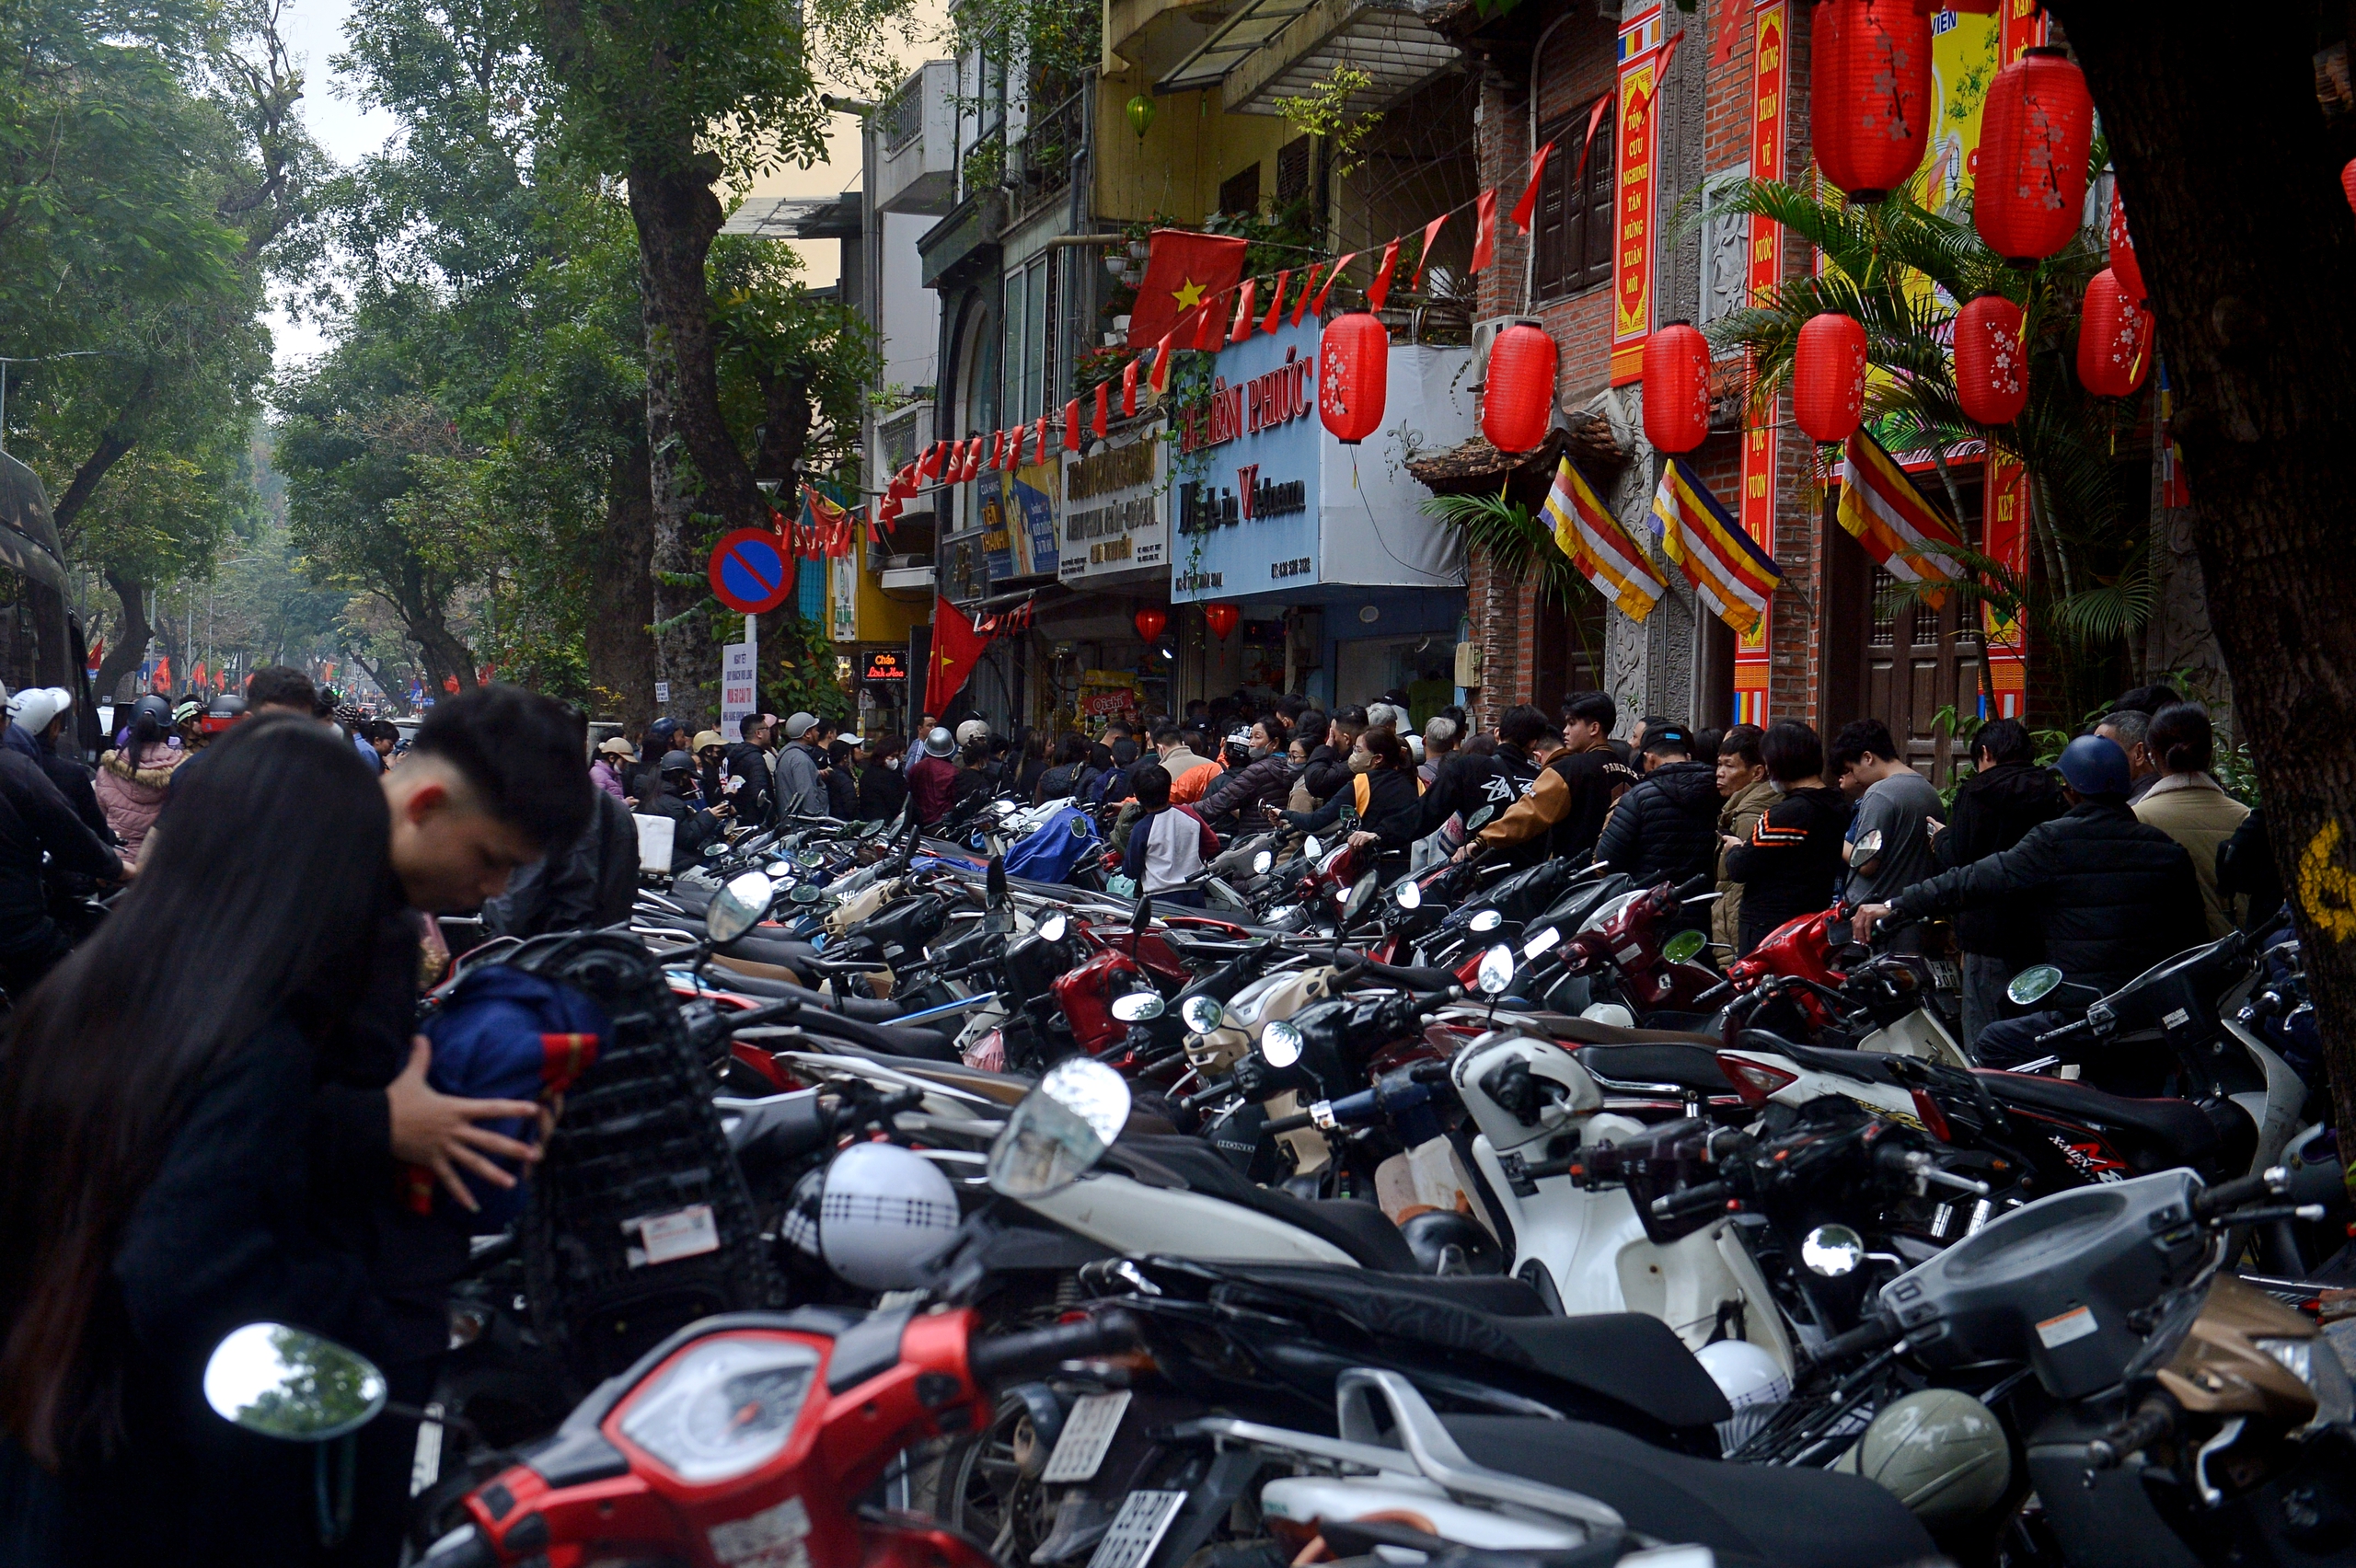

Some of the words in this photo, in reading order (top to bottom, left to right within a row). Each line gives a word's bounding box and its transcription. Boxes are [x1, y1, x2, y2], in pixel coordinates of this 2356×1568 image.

[1760, 42, 1779, 75] MỪNG
[1759, 87, 1777, 122] XUÂN
[1628, 137, 1644, 159] CỰU
[1762, 130, 1772, 167] VỀ
[1623, 162, 1648, 188] NGHINH
[1627, 190, 1642, 213] TÂN
[1623, 218, 1644, 241] MỪNG
[1623, 244, 1643, 268] XUÂN
[1754, 230, 1773, 264] NƯỚC
[1625, 272, 1638, 294] MỚI
[1751, 428, 1765, 457] TỤC
[1237, 464, 1306, 520] Vietnam
[1748, 472, 1767, 500] VƯƠN
[1996, 481, 2015, 523] KẾT
[867, 666, 885, 677] Linh
[886, 666, 904, 677] Hoa
[874, 654, 895, 665] Cháo
[1093, 696, 1124, 711] Oishi
[1217, 1139, 1255, 1153] HOND
[2048, 1135, 2108, 1168] X-MEN
